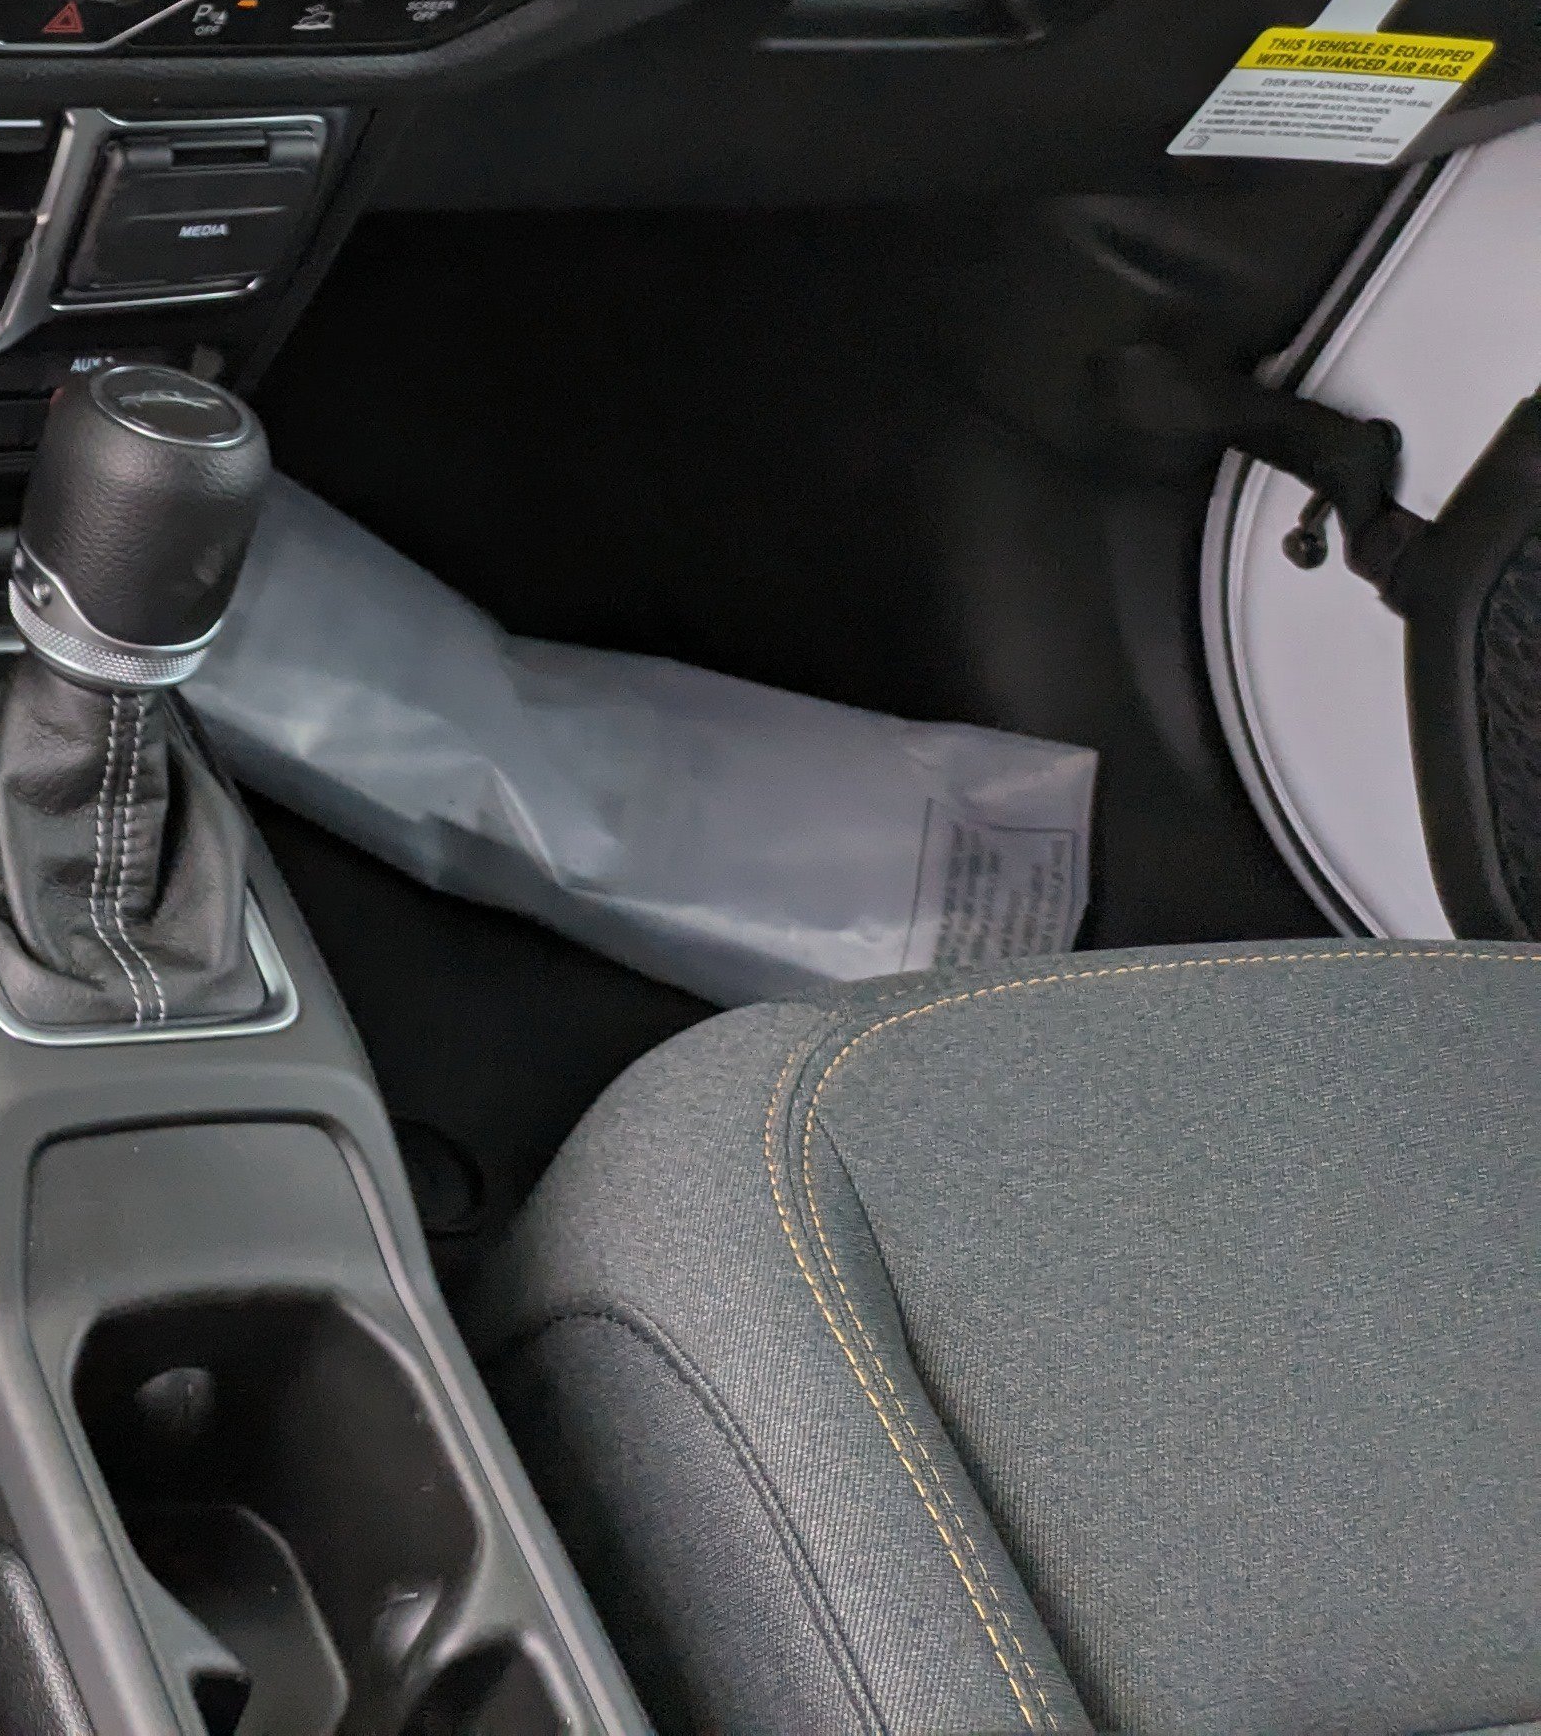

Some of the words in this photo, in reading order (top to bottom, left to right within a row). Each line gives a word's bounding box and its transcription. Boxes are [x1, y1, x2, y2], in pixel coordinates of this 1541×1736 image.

[1268, 37, 1306, 51] THIS
[1306, 39, 1376, 55] VEHICLE
[1374, 43, 1391, 56] IS
[1393, 44, 1475, 63] EQUIPPED
[1256, 53, 1299, 65] WITH
[1299, 55, 1386, 71] ADVANCED
[1385, 60, 1416, 73] AIR
[1417, 62, 1462, 77] BAGS
